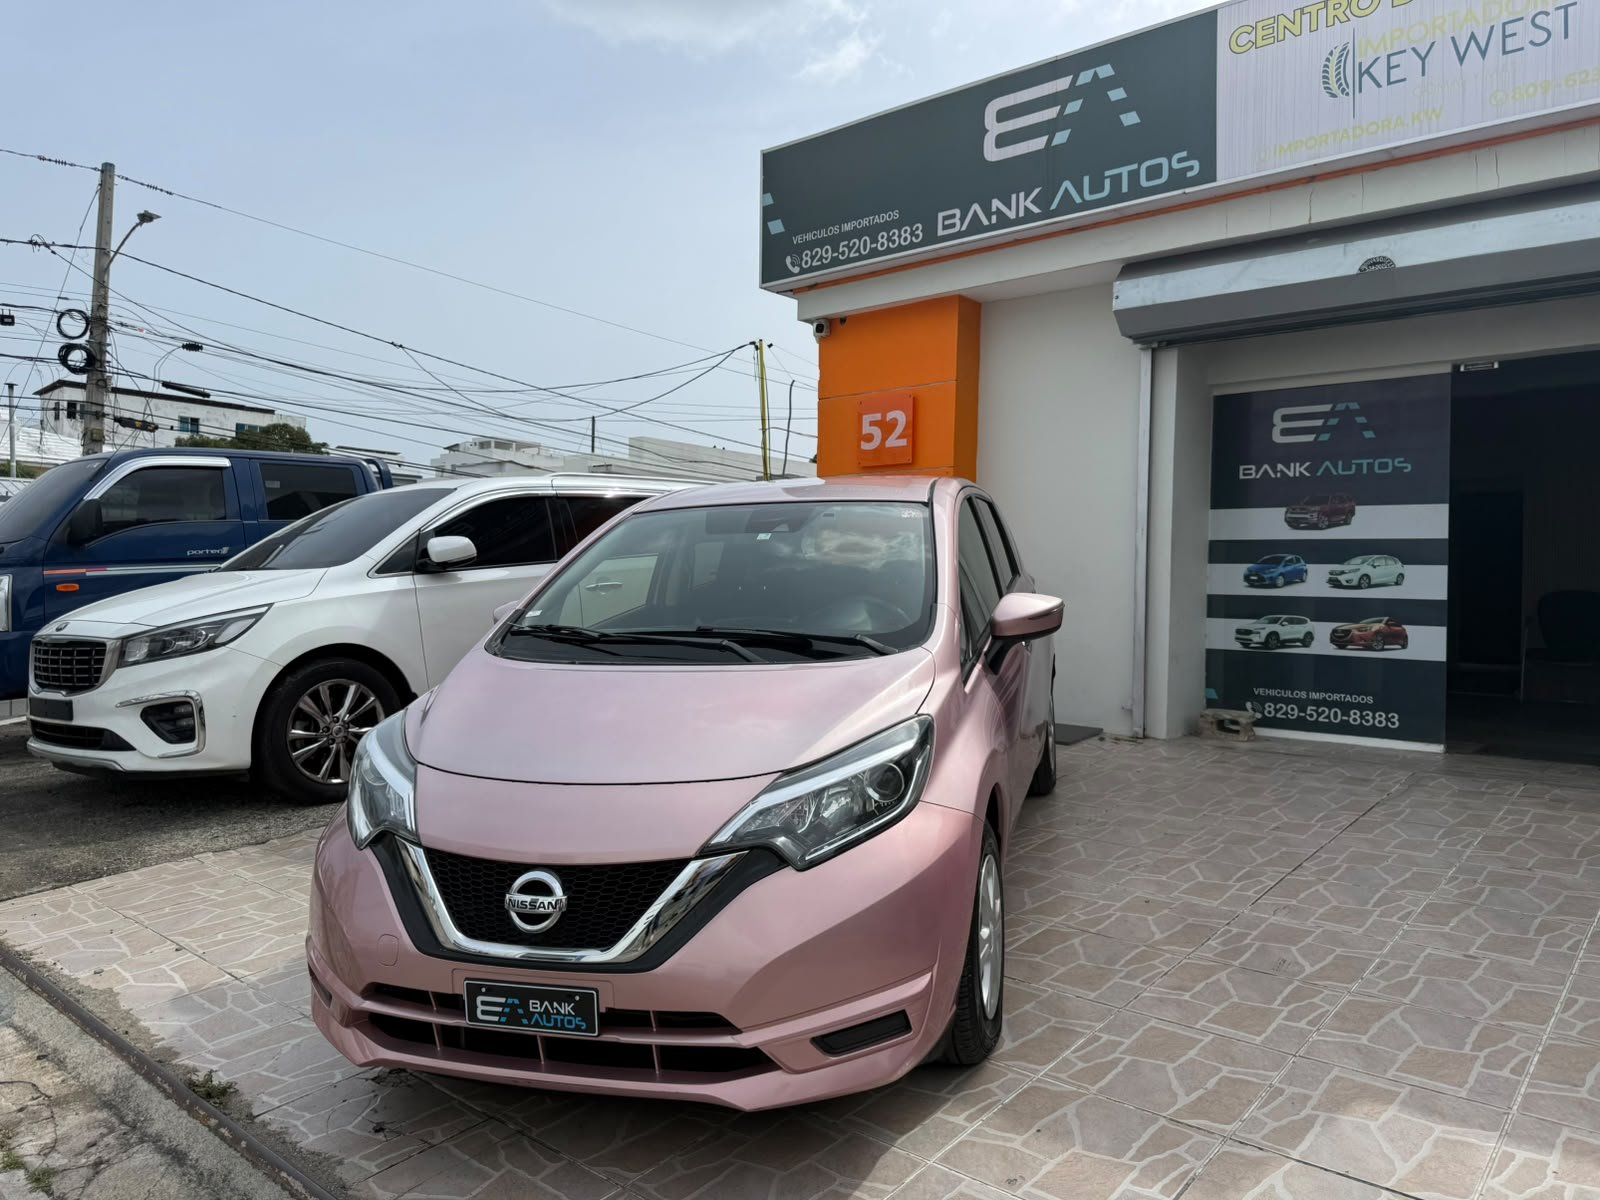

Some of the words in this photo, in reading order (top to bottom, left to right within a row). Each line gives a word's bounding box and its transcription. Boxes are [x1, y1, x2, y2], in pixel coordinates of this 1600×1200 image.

[1229, 0, 1381, 55] CENTRO
[1358, 41, 1437, 94] KEY
[1450, 1, 1578, 67] WEST
[936, 186, 1043, 237] BANK
[1049, 150, 1201, 211] AUTOS
[792, 225, 840, 245] VEHICULOS
[841, 209, 900, 233] IMPORTADOS
[801, 223, 923, 269] 829-520-8383
[860, 410, 908, 450] 52
[1239, 461, 1312, 480] BANK
[1316, 457, 1412, 477] AUTOS
[1253, 687, 1307, 700] VEHICULOS
[1308, 691, 1374, 705] IMPORTADOS
[1263, 702, 1400, 729] 829-520-8383
[508, 898, 562, 911] NISSAN
[529, 999, 575, 1016] BANK
[530, 1013, 587, 1030] AUTOS
